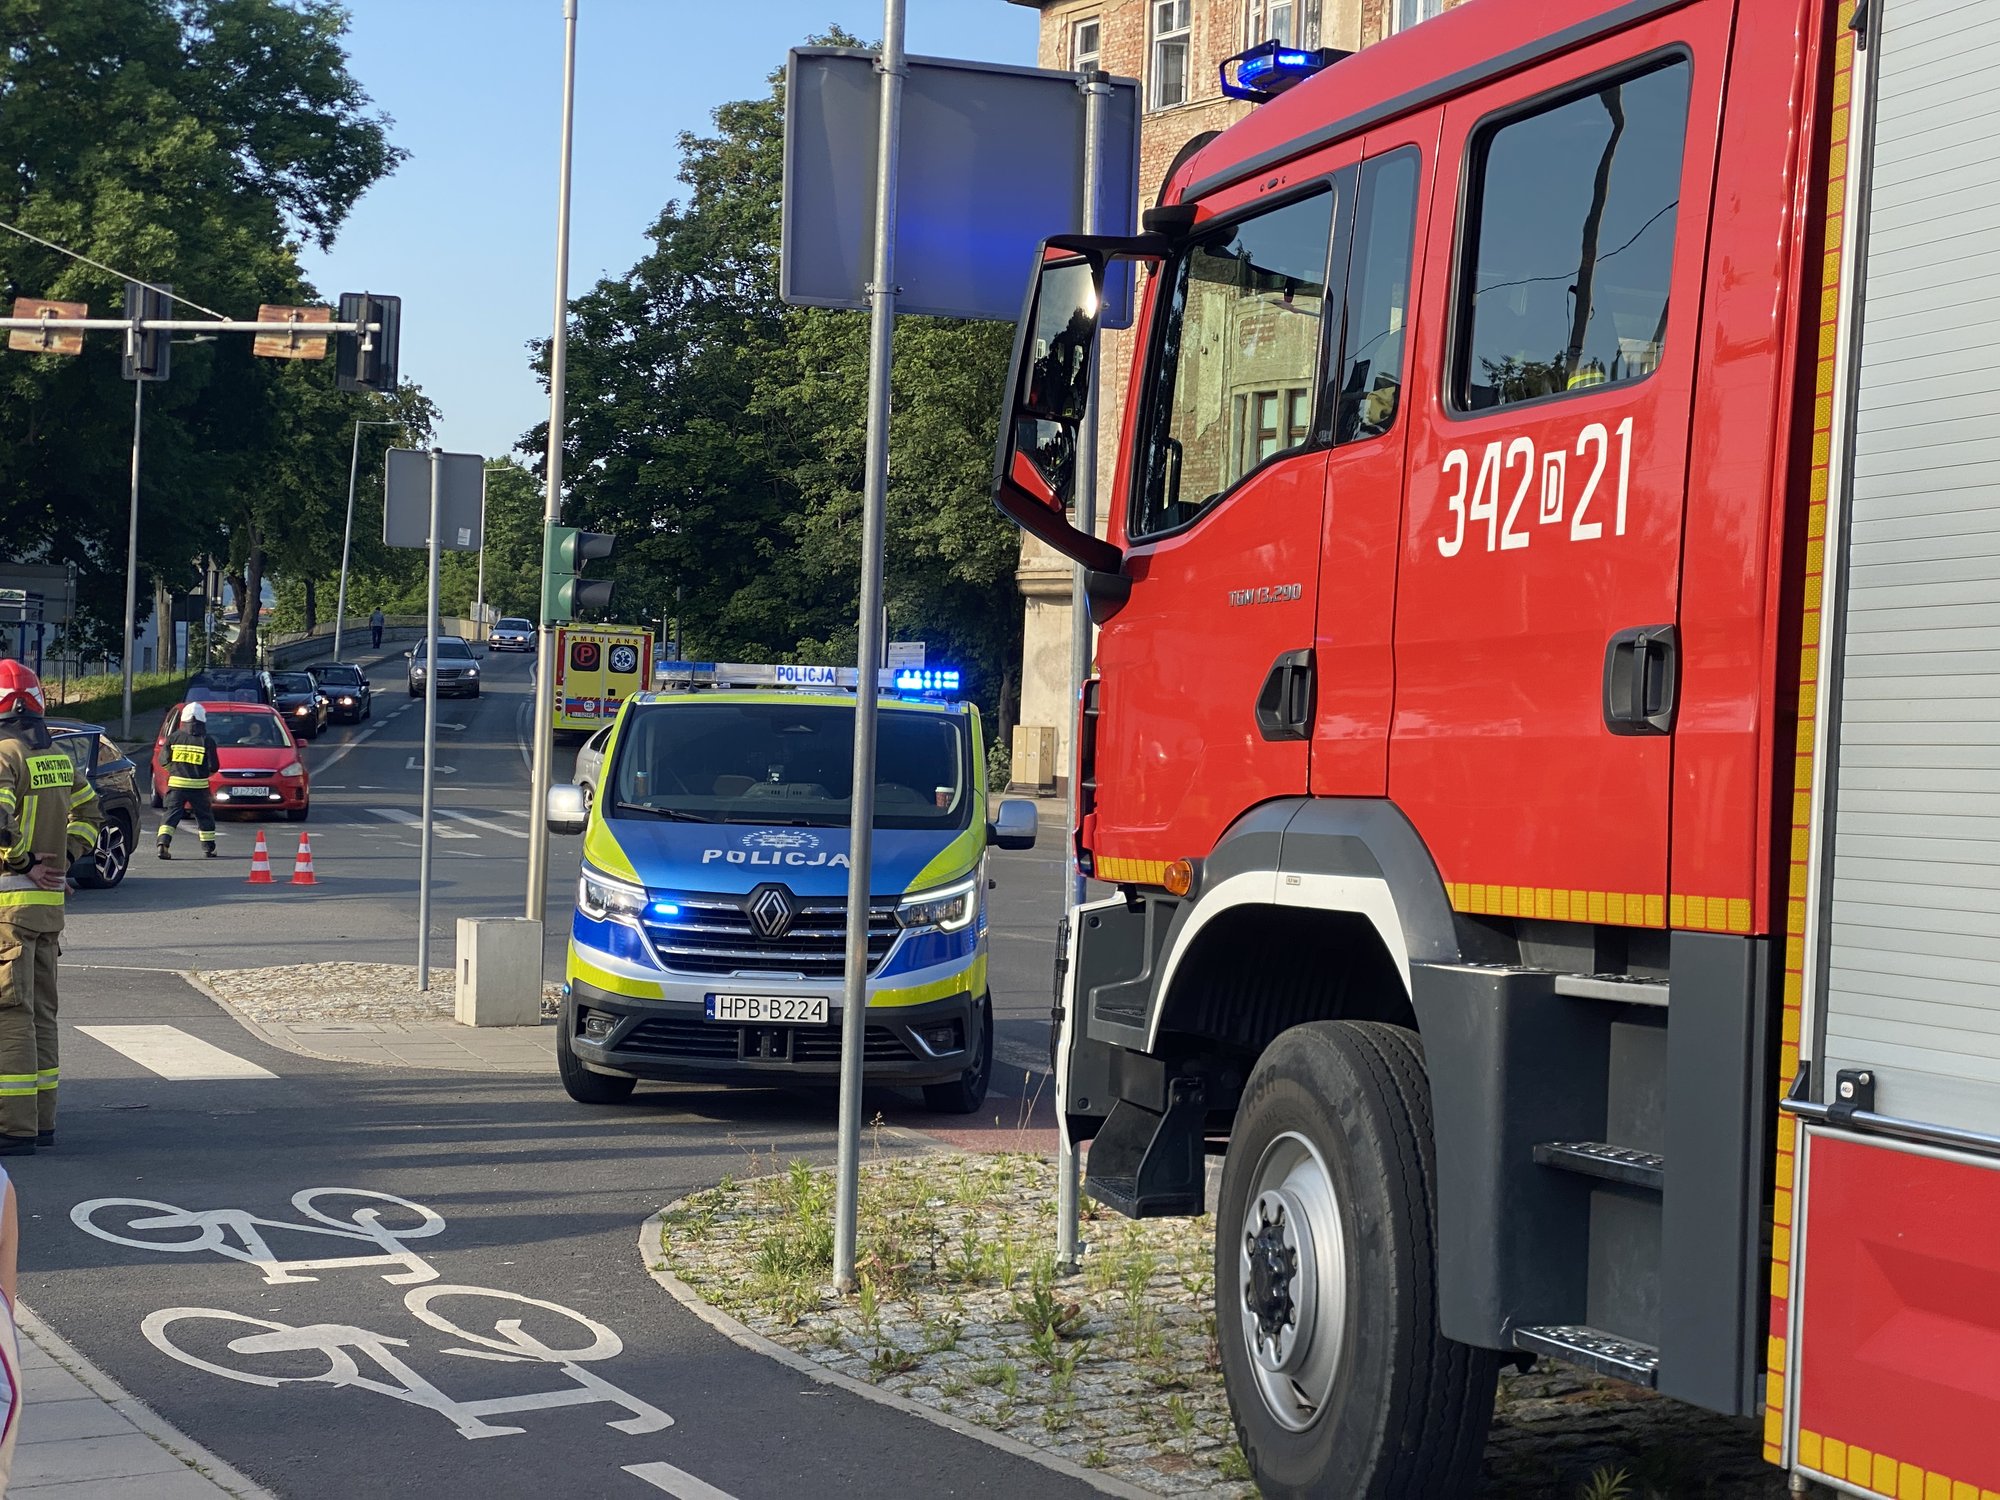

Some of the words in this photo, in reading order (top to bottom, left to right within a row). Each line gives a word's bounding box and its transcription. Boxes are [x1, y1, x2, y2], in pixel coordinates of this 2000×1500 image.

[1229, 588, 1255, 607] TGM
[1256, 583, 1302, 604] 13.290
[571, 635, 639, 645] AMBULANS
[777, 666, 835, 683] POLICJA
[702, 849, 850, 869] POLICJA
